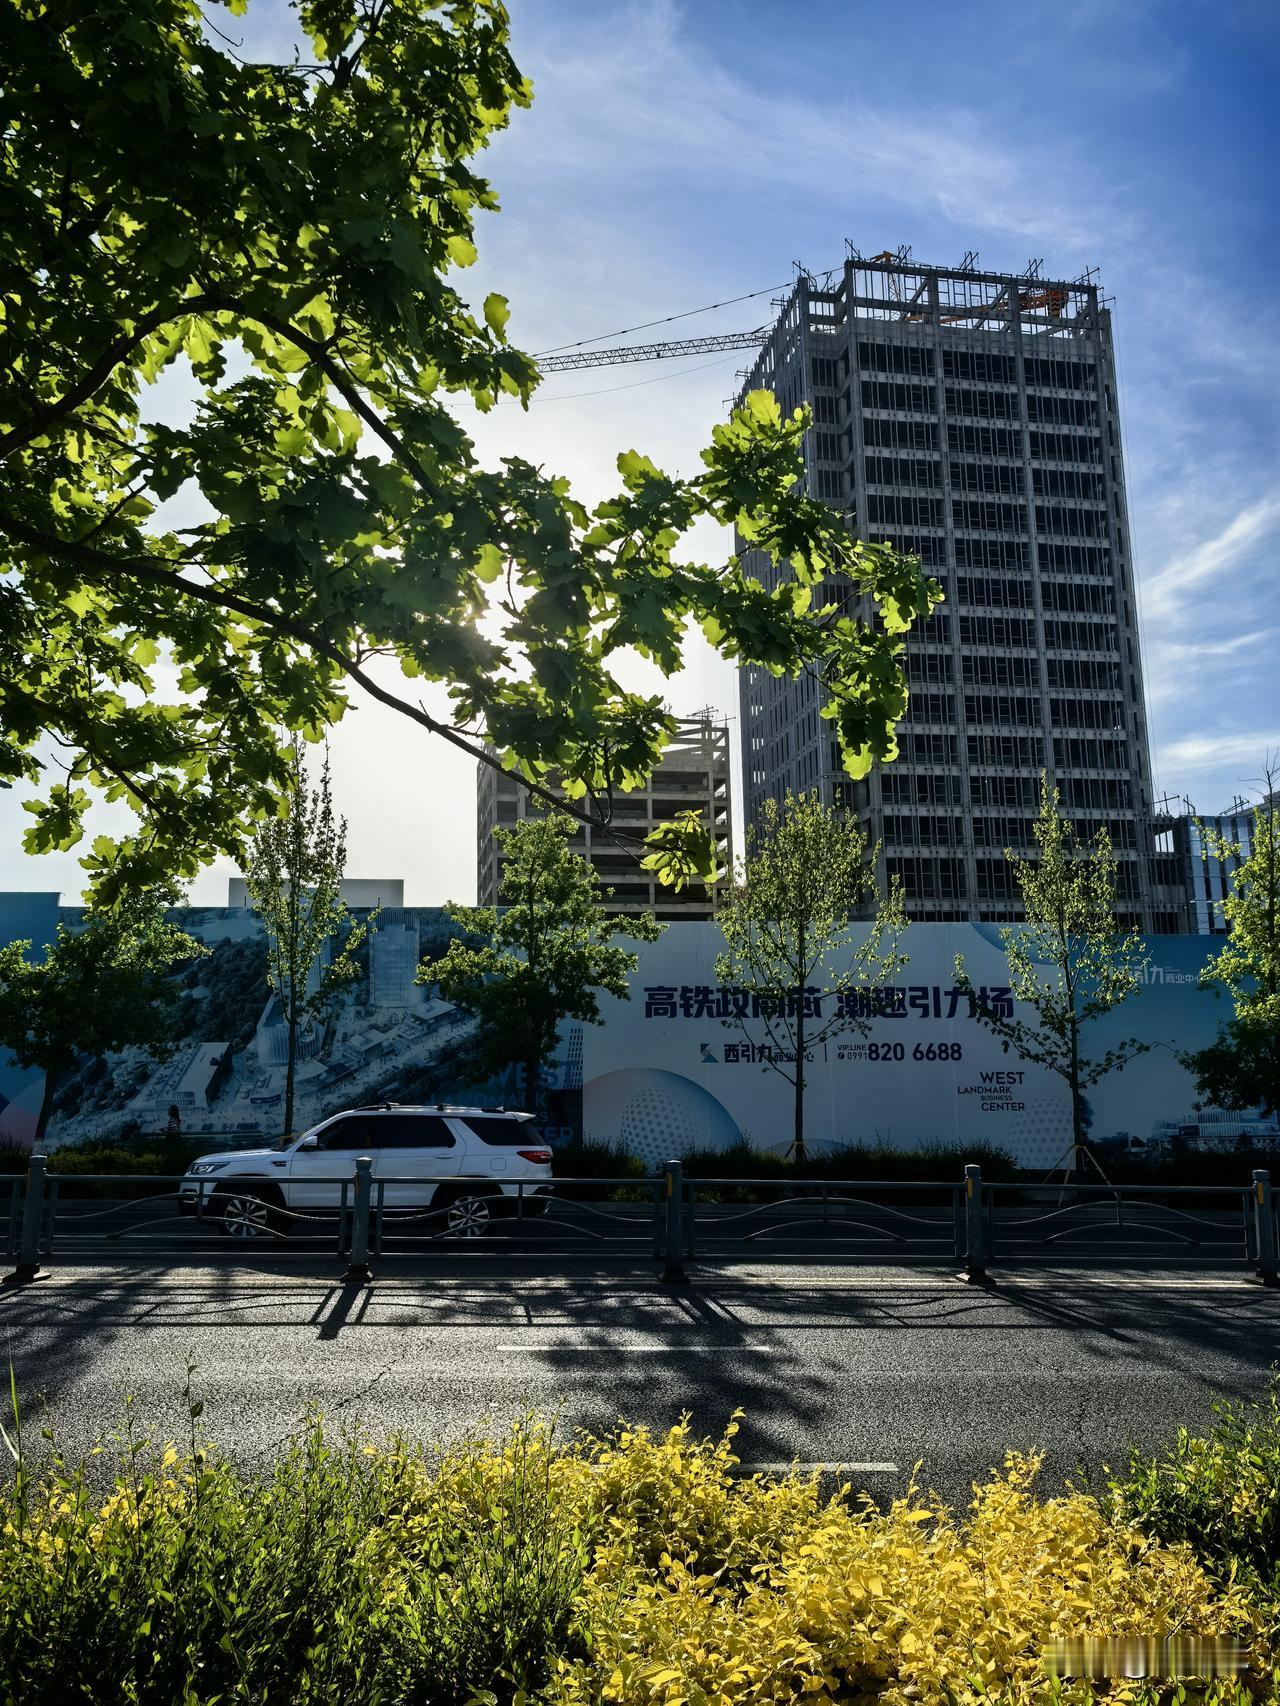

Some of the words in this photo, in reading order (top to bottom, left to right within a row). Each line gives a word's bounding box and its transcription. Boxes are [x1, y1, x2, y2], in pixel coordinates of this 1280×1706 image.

[724, 1044, 772, 1063] 西引力
[847, 1052, 868, 1060] 0991
[868, 1043, 905, 1061] 820
[912, 1043, 963, 1061] 6688
[979, 1071, 1025, 1084] WEST
[957, 1086, 1013, 1094] LANDMARK
[981, 1102, 1025, 1111] CENTER
